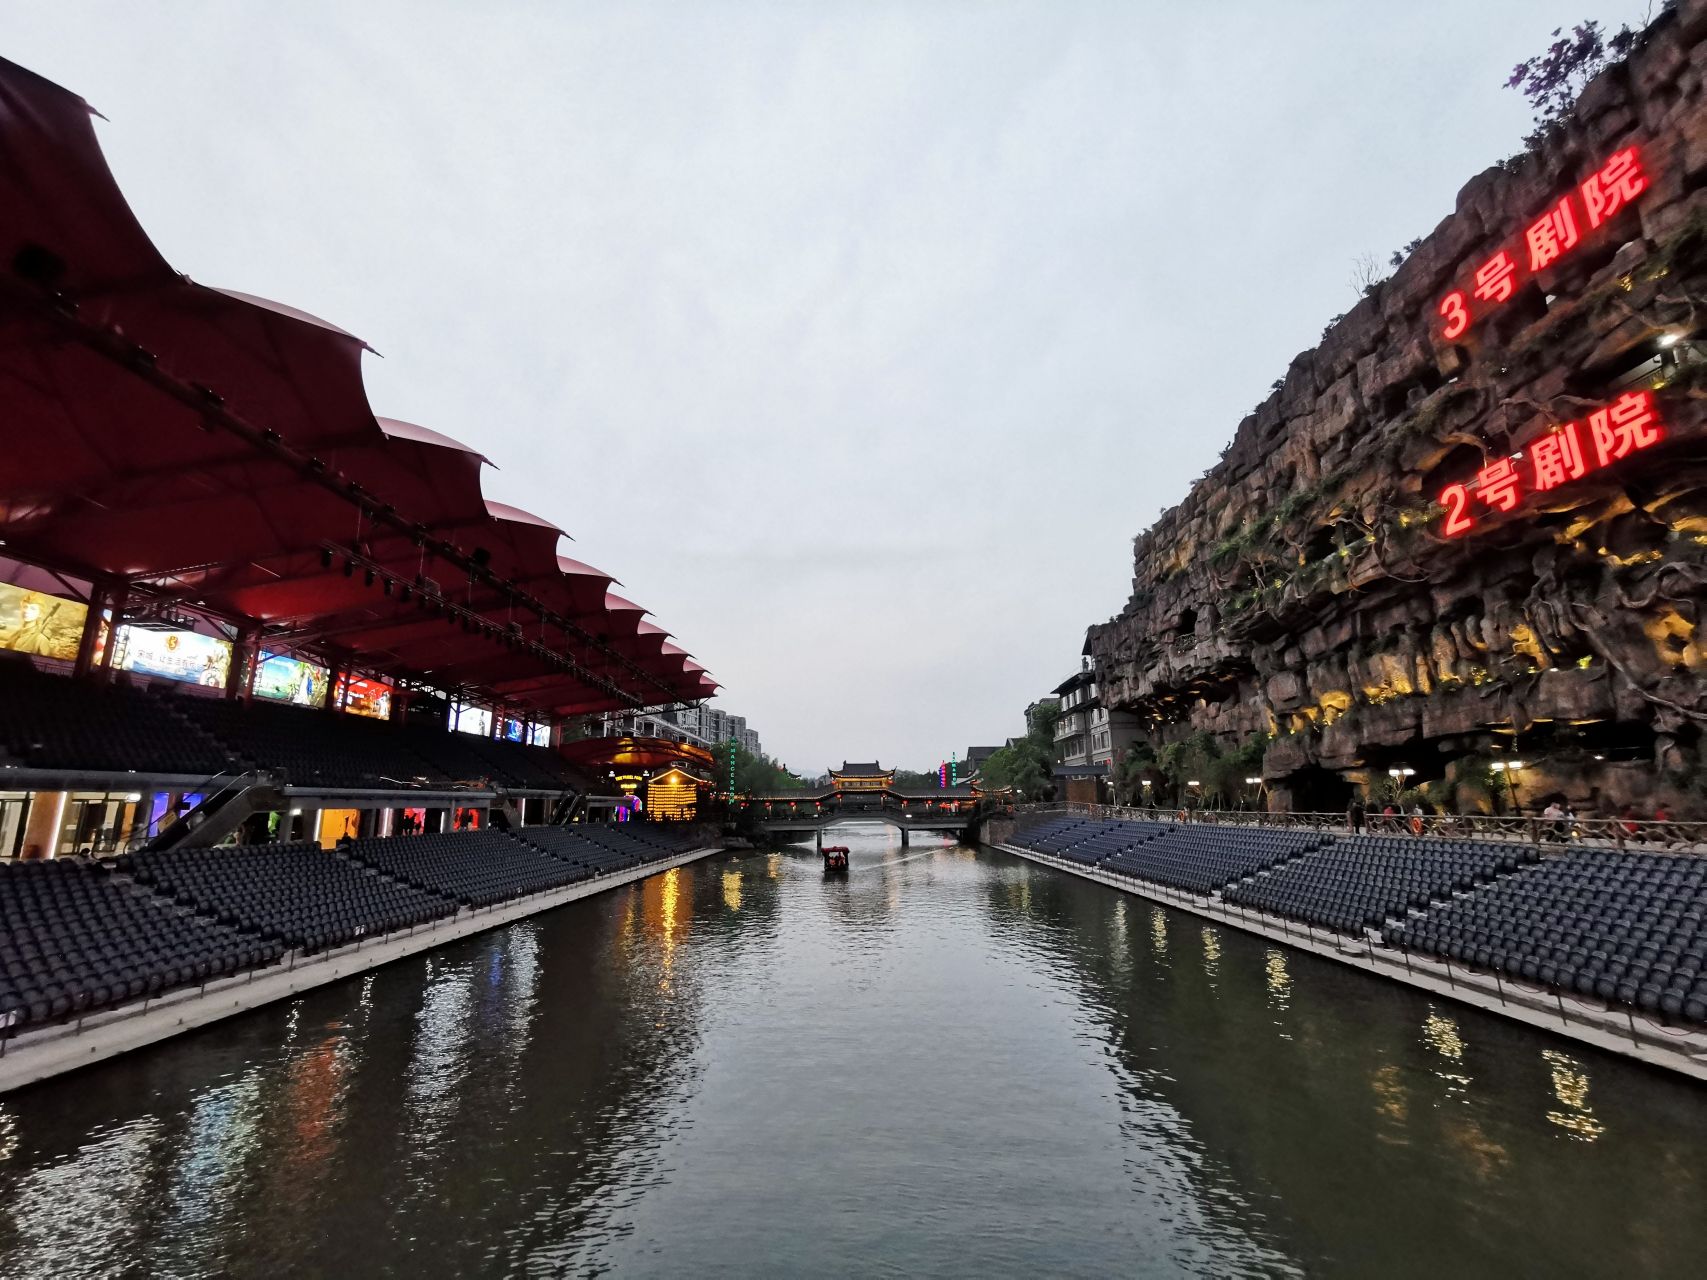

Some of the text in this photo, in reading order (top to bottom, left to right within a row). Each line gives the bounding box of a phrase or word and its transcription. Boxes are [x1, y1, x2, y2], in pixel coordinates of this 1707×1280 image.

[1439, 146, 1647, 340] 3号剧院
[1439, 390, 1660, 538] 2号剧院
